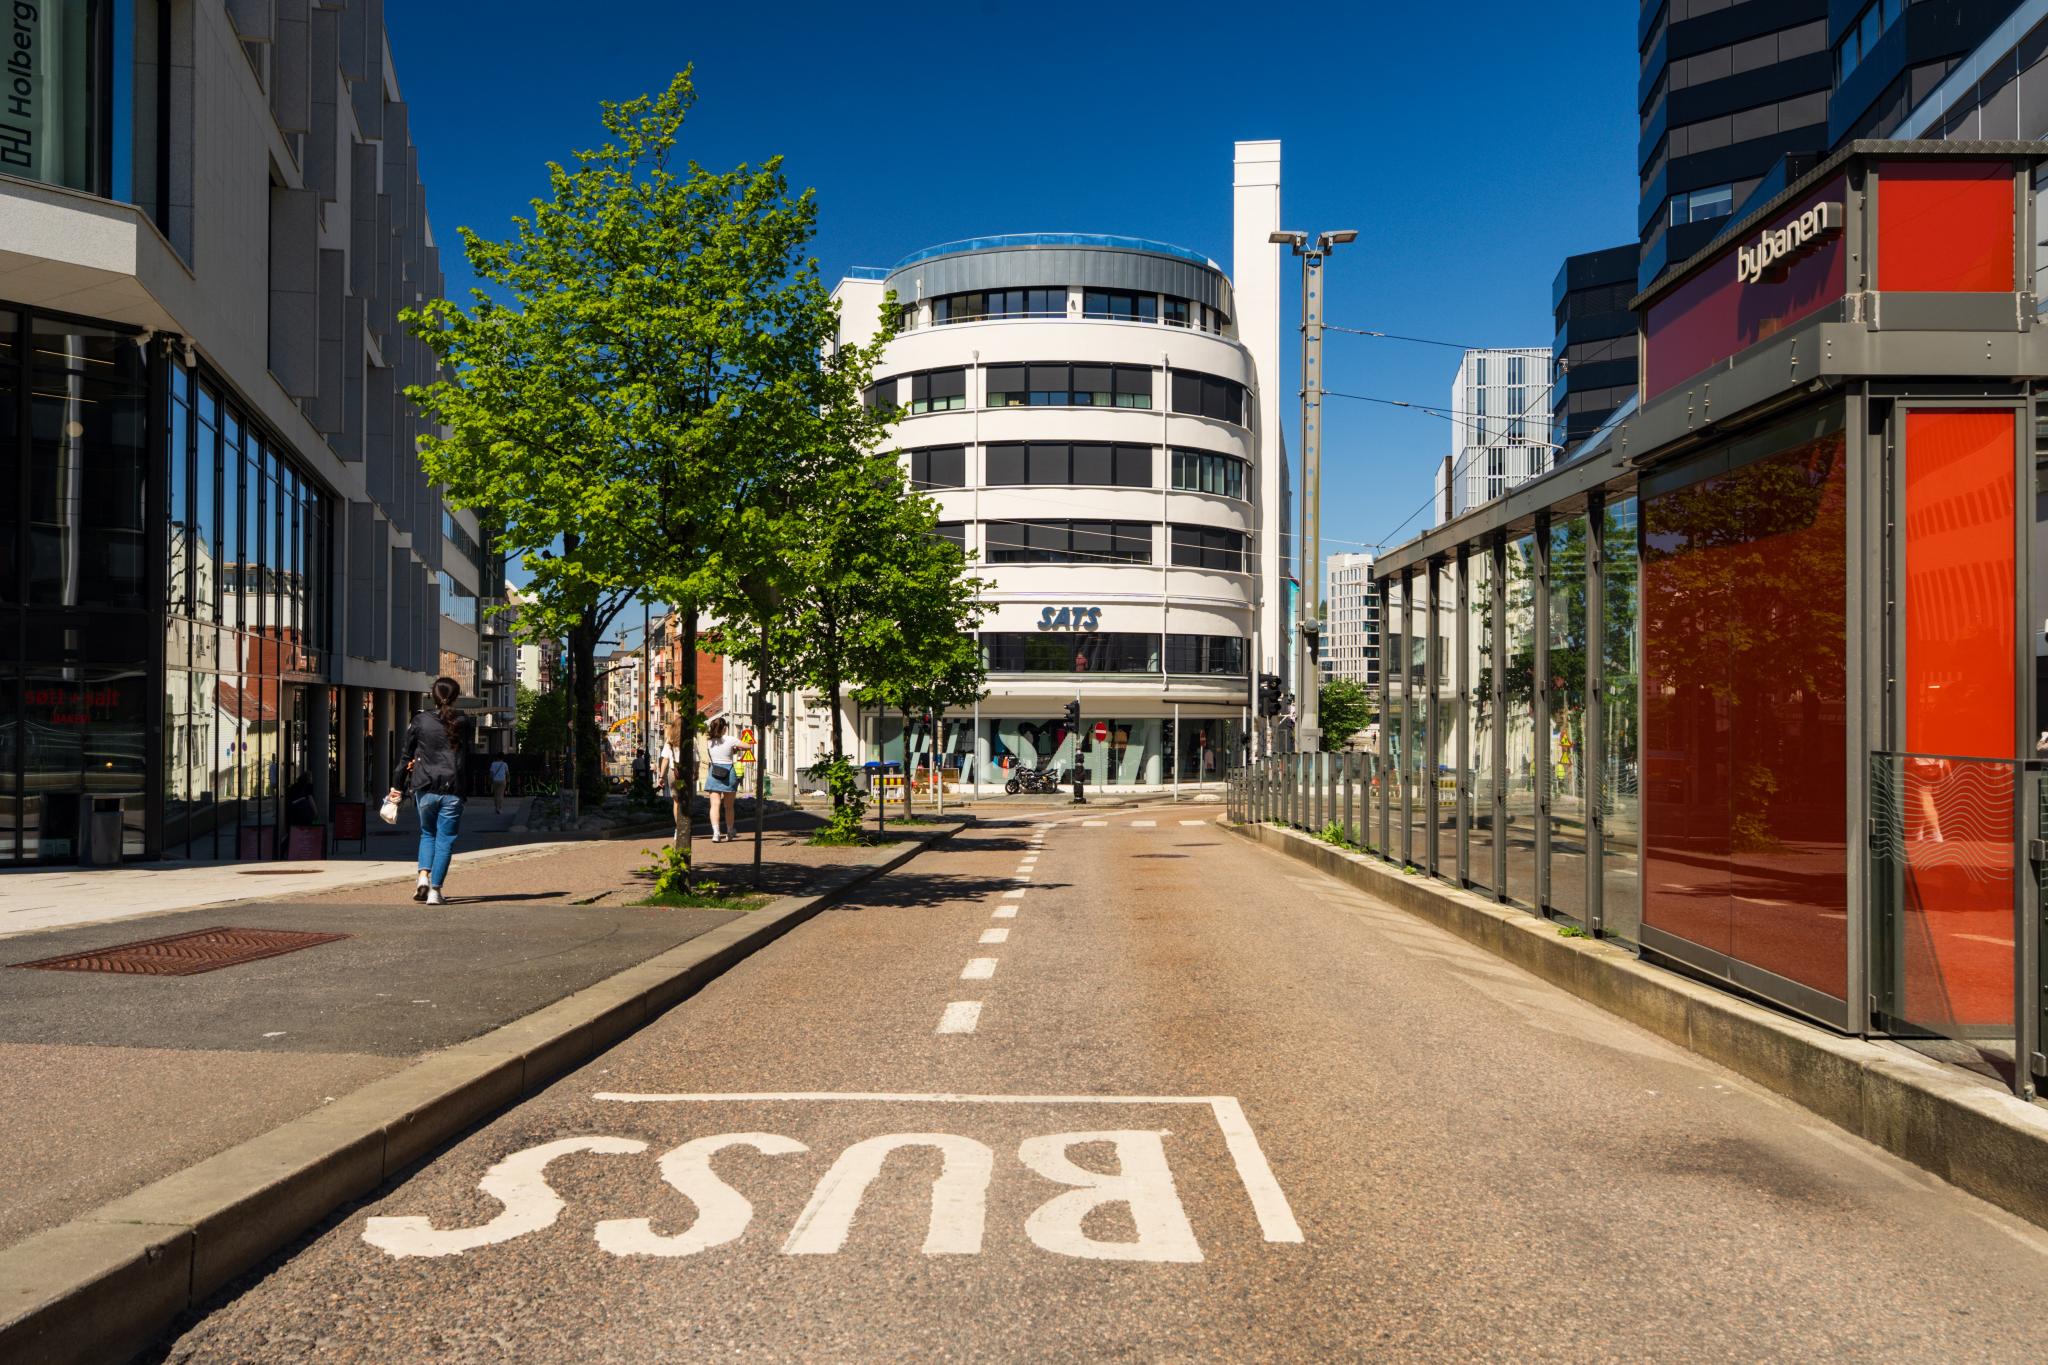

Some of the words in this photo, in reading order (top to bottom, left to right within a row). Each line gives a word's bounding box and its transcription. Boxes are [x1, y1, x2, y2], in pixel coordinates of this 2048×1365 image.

[7, 0, 38, 118] Holberg
[1737, 201, 1830, 284] bybanen
[1037, 606, 1102, 632] SATS
[361, 1129, 1206, 1264] BUSS
